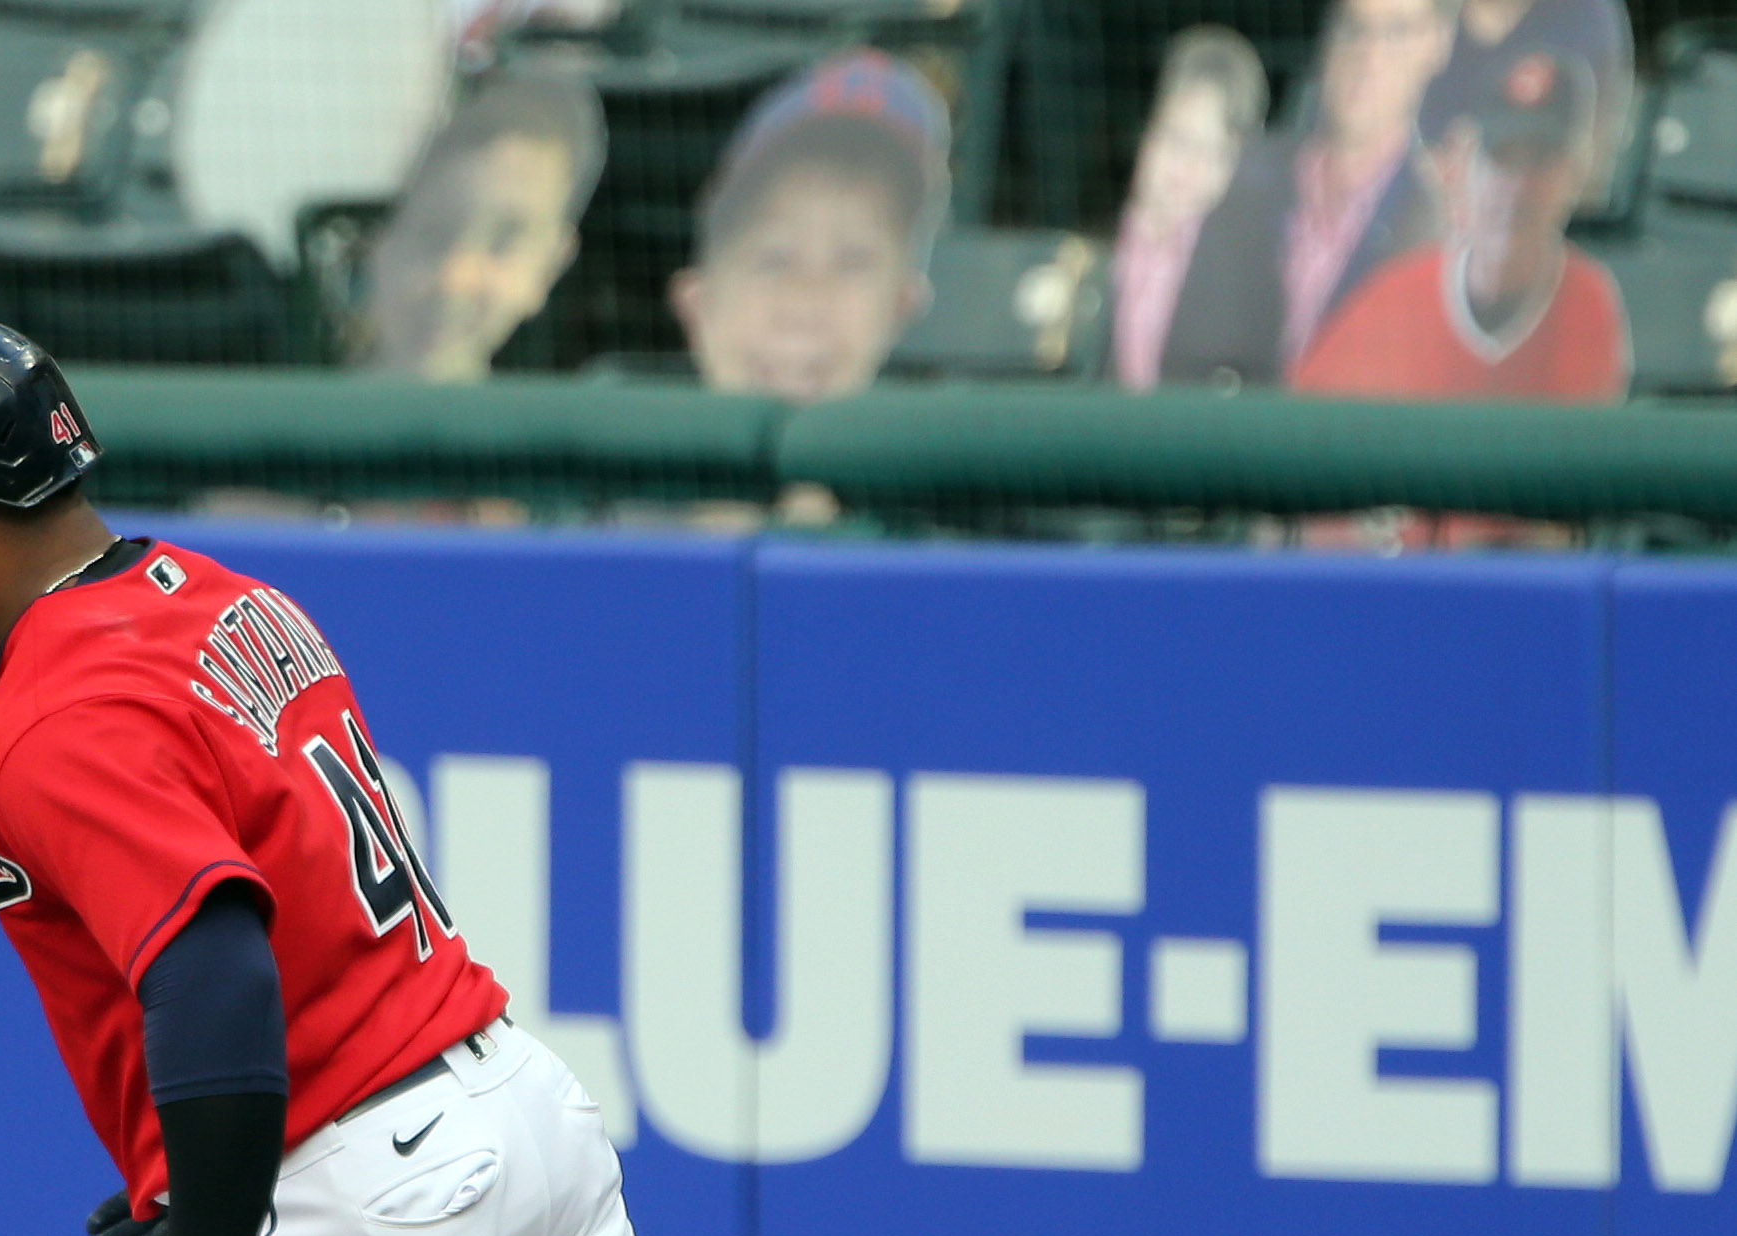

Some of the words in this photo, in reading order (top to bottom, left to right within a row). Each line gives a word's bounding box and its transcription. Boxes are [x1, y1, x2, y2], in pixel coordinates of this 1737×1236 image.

[50, 402, 82, 445] 41
[300, 708, 459, 964] 41
[375, 752, 1737, 1196] LUE-EM
